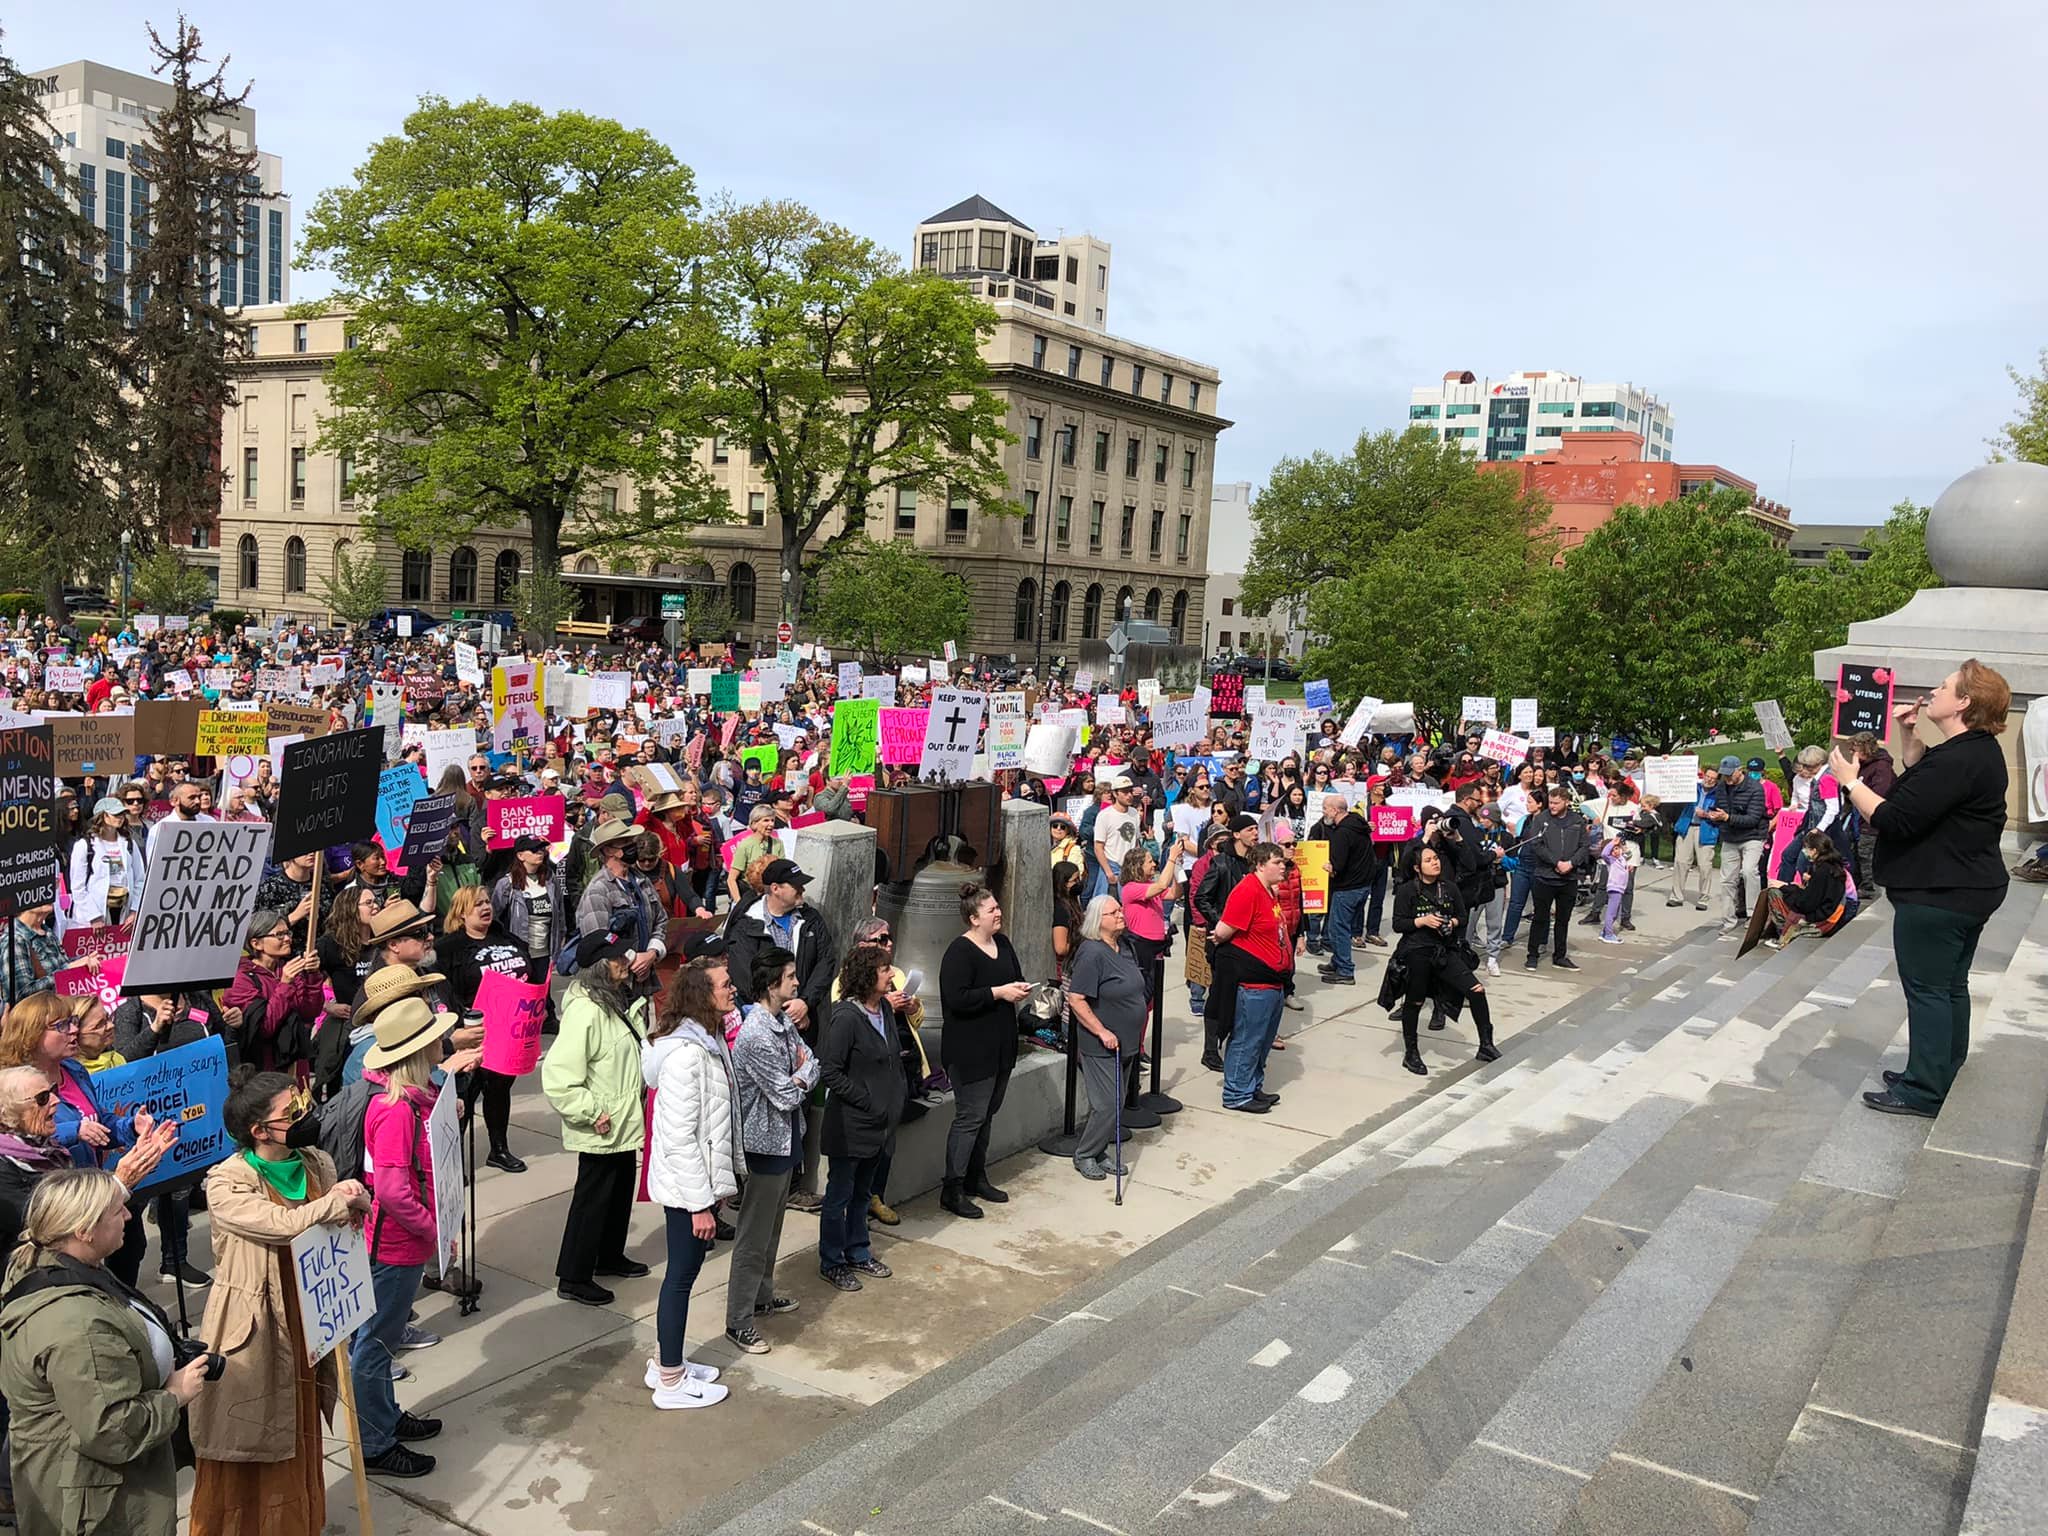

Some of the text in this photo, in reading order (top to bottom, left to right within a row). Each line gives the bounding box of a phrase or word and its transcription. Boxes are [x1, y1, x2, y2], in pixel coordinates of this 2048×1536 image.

[1849, 673, 1862, 682] NO
[498, 691, 540, 706] UTERUS
[938, 694, 957, 703] KEEP
[961, 695, 982, 705] YOUR
[1855, 689, 1884, 700] UTERUS
[267, 707, 325, 724] REPRODUCTIVE
[996, 702, 1020, 714] UNTIL
[1166, 700, 1193, 718] ABORT
[1257, 705, 1268, 717] NO
[1270, 706, 1299, 721] COUNTRY
[1858, 711, 1872, 719] NO
[211, 711, 238, 722] DREAM
[239, 711, 266, 723] WOMEN
[865, 719, 873, 729] 4
[80, 720, 98, 731] NO
[200, 725, 266, 734] WILL ONE DAY HAVE
[1153, 718, 1201, 737] PATRIARCHY
[0, 728, 50, 763] RTION
[53, 732, 121, 746] COMPULSORY
[201, 735, 266, 745] THE SAME RIGHTS
[502, 735, 540, 751] CHOICE
[1256, 737, 1286, 748] FOR OLD
[1497, 733, 1520, 746] KEEP
[57, 747, 125, 763] PREGNANCY
[208, 744, 220, 754] AS
[293, 734, 368, 770] IGNORANCE
[927, 742, 970, 753] OUT OF MY
[997, 751, 1017, 759] BLACK
[1260, 749, 1278, 758] MEN
[1482, 740, 1531, 760] ABORTION
[1487, 749, 1516, 765] LEGAL
[310, 772, 349, 802] HURTS
[501, 805, 534, 819] BANS
[1377, 811, 1397, 820] BANS
[296, 805, 345, 835] WOMEN
[500, 815, 554, 829] OFF OUR
[1377, 819, 1408, 828] OFF OUR
[411, 823, 427, 833] YOU
[501, 825, 550, 840] BODIES
[1378, 827, 1406, 836] BODIES
[173, 825, 267, 854] DON'T
[161, 855, 253, 881] TREAD
[16, 884, 54, 907] YOURS
[160, 884, 253, 911] ON MY
[137, 909, 250, 951] PRIVACY
[77, 932, 115, 947] BANS
[68, 973, 109, 996] BANS
[142, 1060, 186, 1089] nothing
[188, 1054, 223, 1077] scary
[183, 1105, 205, 1120] YOU
[298, 1232, 350, 1292] FUCK
[307, 1261, 351, 1314] THIS
[318, 1281, 365, 1343] SHIT
